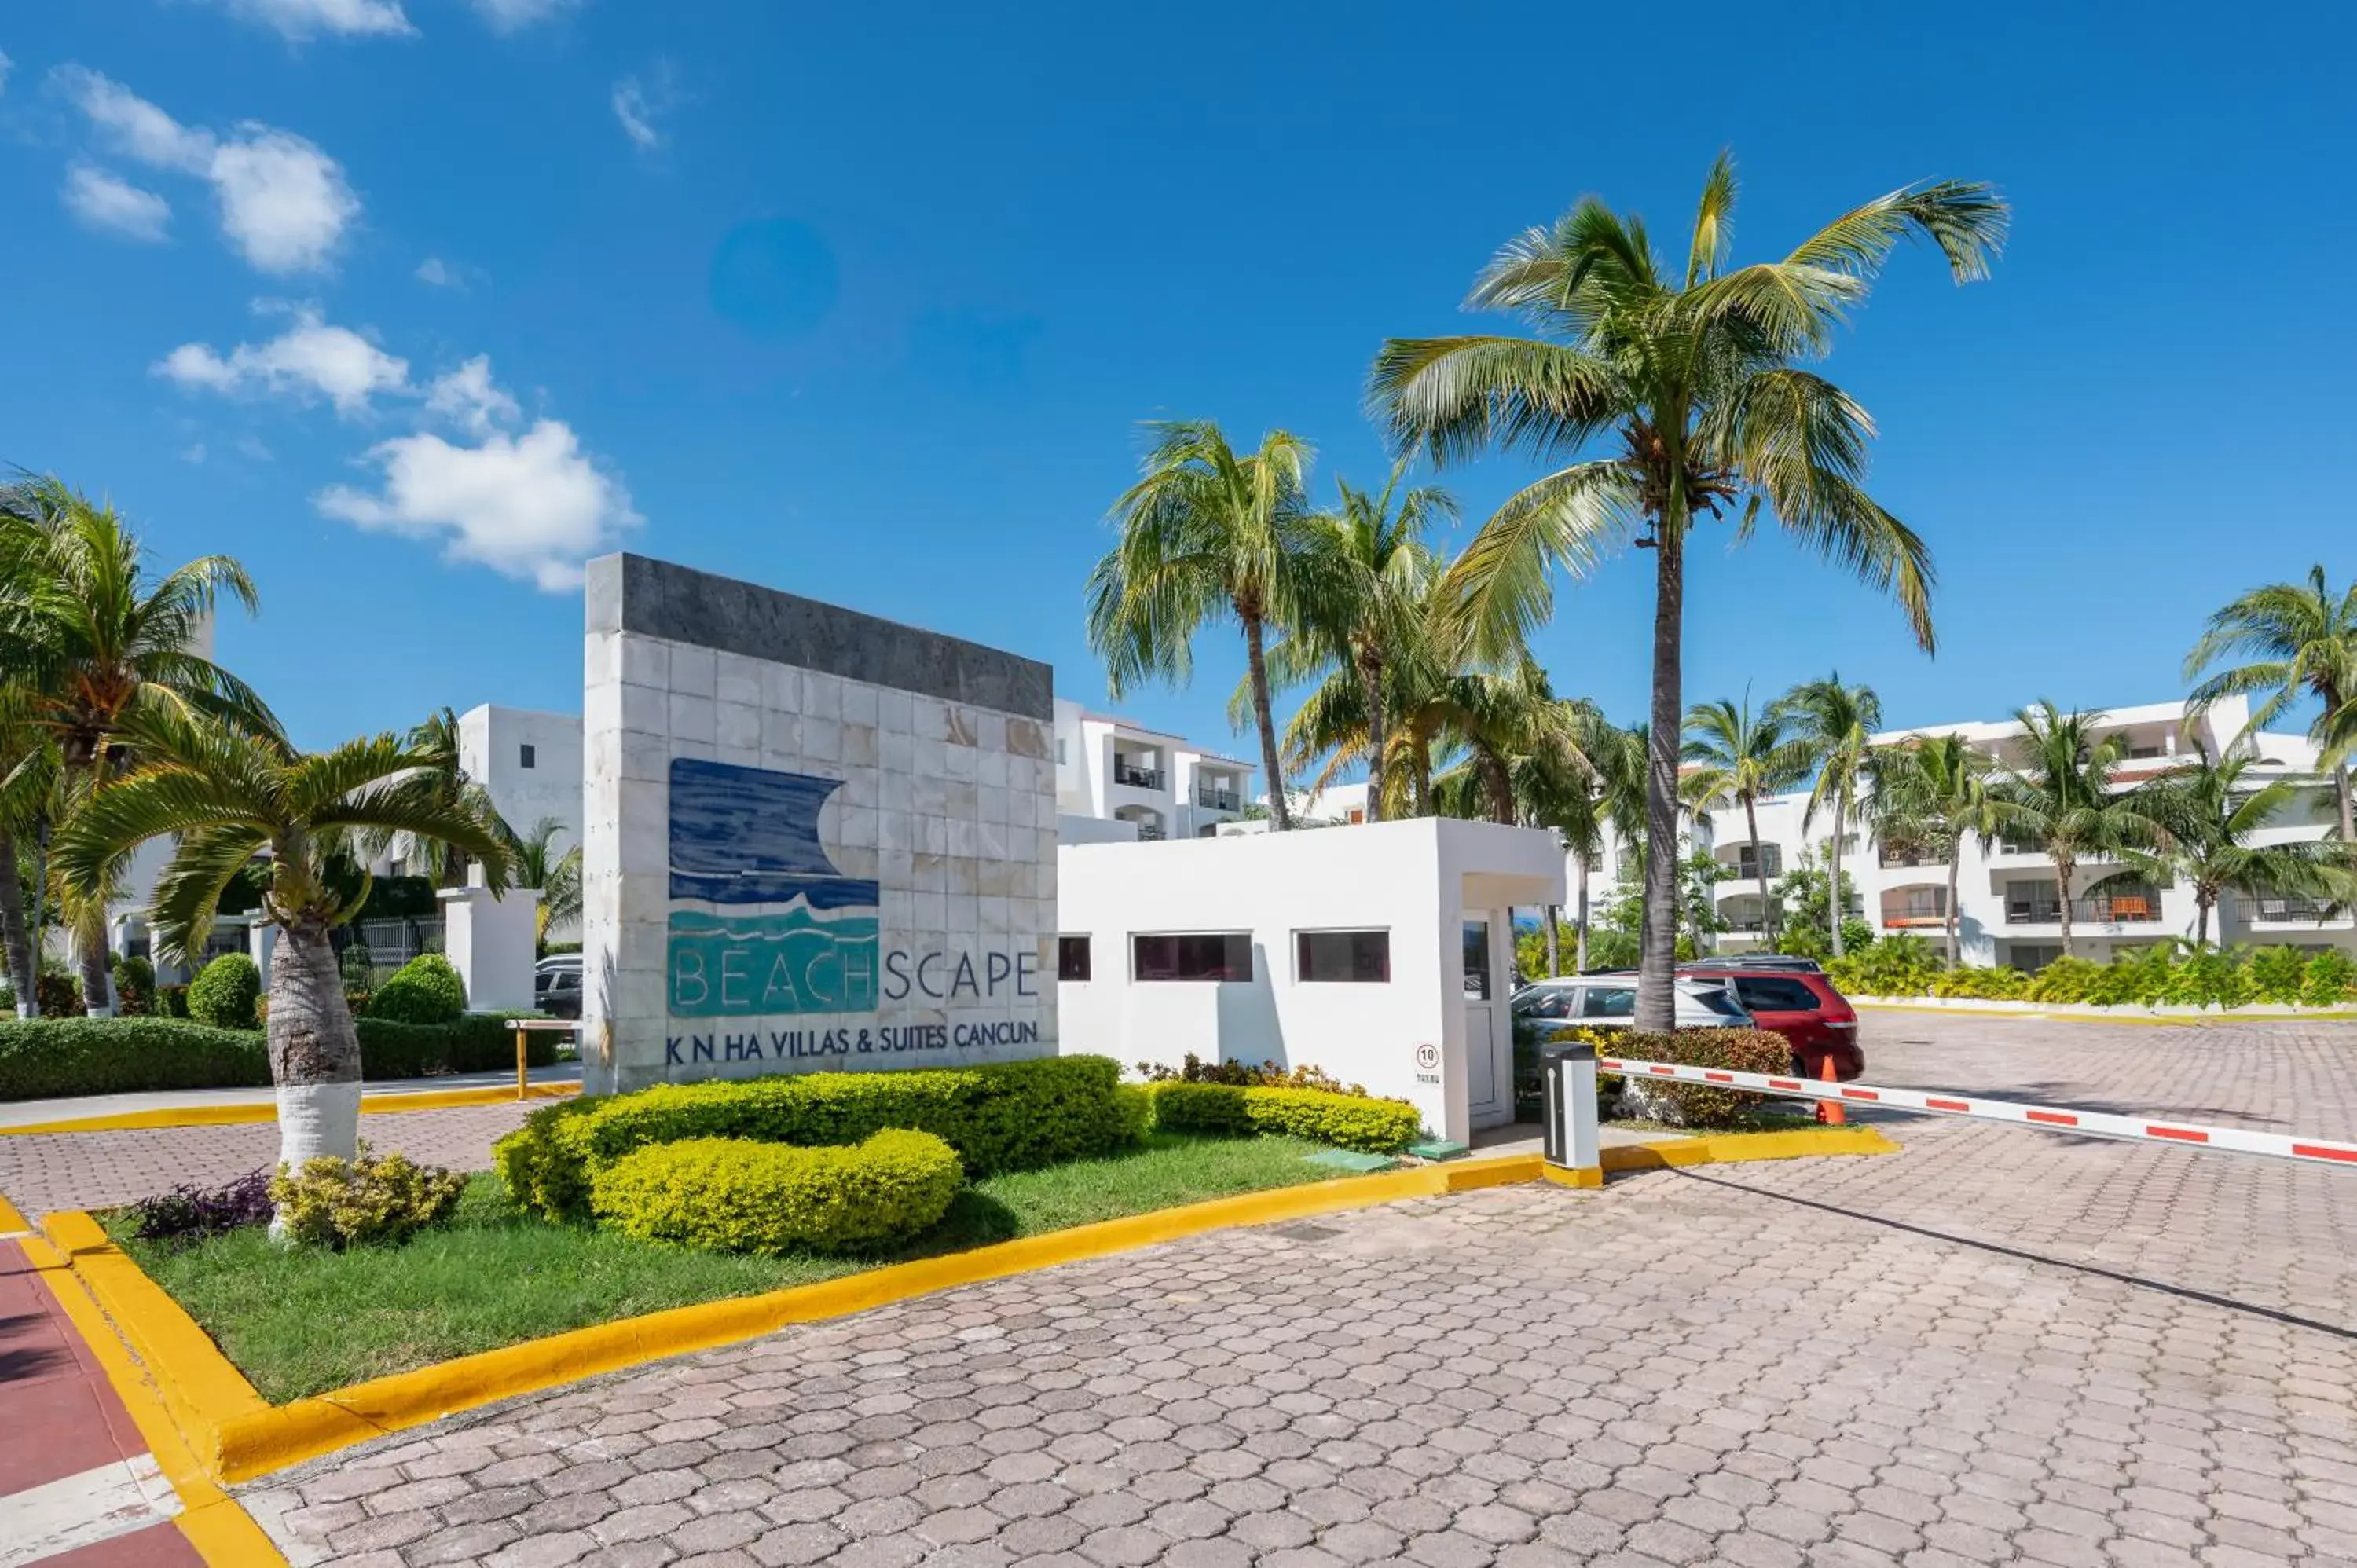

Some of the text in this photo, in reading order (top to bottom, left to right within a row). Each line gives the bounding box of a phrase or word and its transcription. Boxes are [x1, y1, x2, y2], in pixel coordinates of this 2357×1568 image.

[725, 1032, 763, 1061] HA
[771, 1028, 849, 1058] VILLAS
[856, 1028, 873, 1053] &
[880, 1024, 948, 1052] SUITES
[953, 1021, 1039, 1048] CANCUN
[1421, 1049, 1434, 1061] 10
